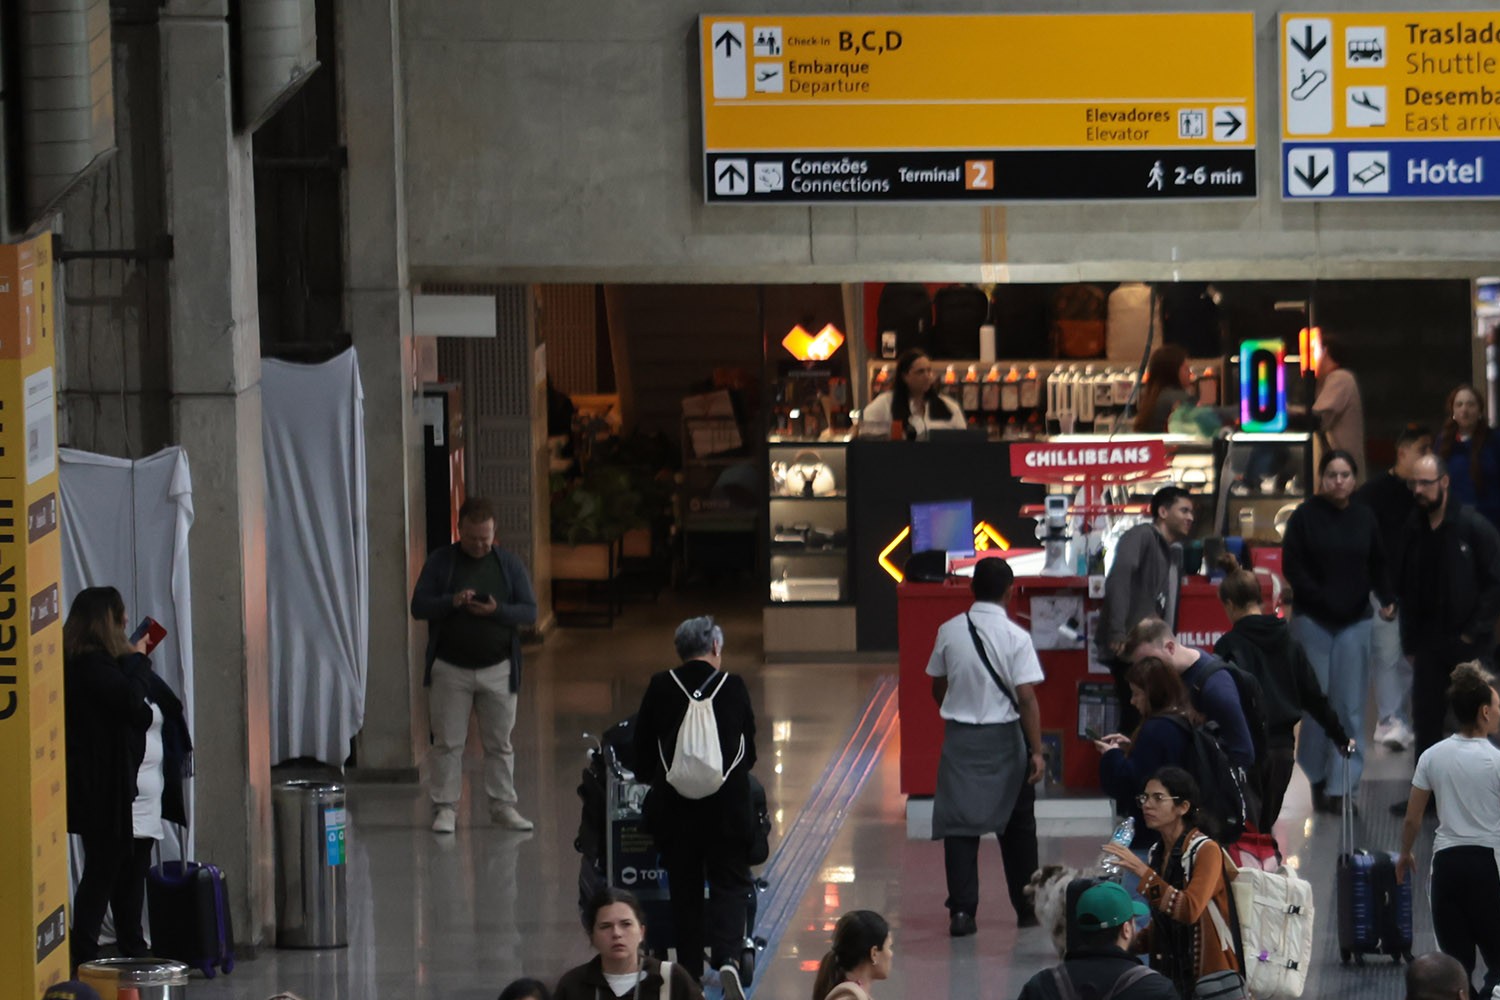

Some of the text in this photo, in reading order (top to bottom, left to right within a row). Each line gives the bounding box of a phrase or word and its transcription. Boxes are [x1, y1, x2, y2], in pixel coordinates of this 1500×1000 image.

[788, 31, 902, 55] Check-in B,C,D
[789, 60, 869, 77] Embarque
[1407, 52, 1496, 74] Shuttle
[790, 77, 869, 96] Departure
[1086, 108, 1170, 122] Elevadores
[1405, 112, 1448, 131] East
[1087, 126, 1149, 141] Elevator
[791, 158, 867, 177] Conexões
[899, 164, 988, 187] Terminal 2
[1175, 167, 1242, 184] 2-6 min
[1408, 157, 1482, 183] Hotel
[792, 176, 889, 192] Connections
[1025, 447, 1150, 467] CHILLIBEANS
[640, 869, 667, 880] TOT
